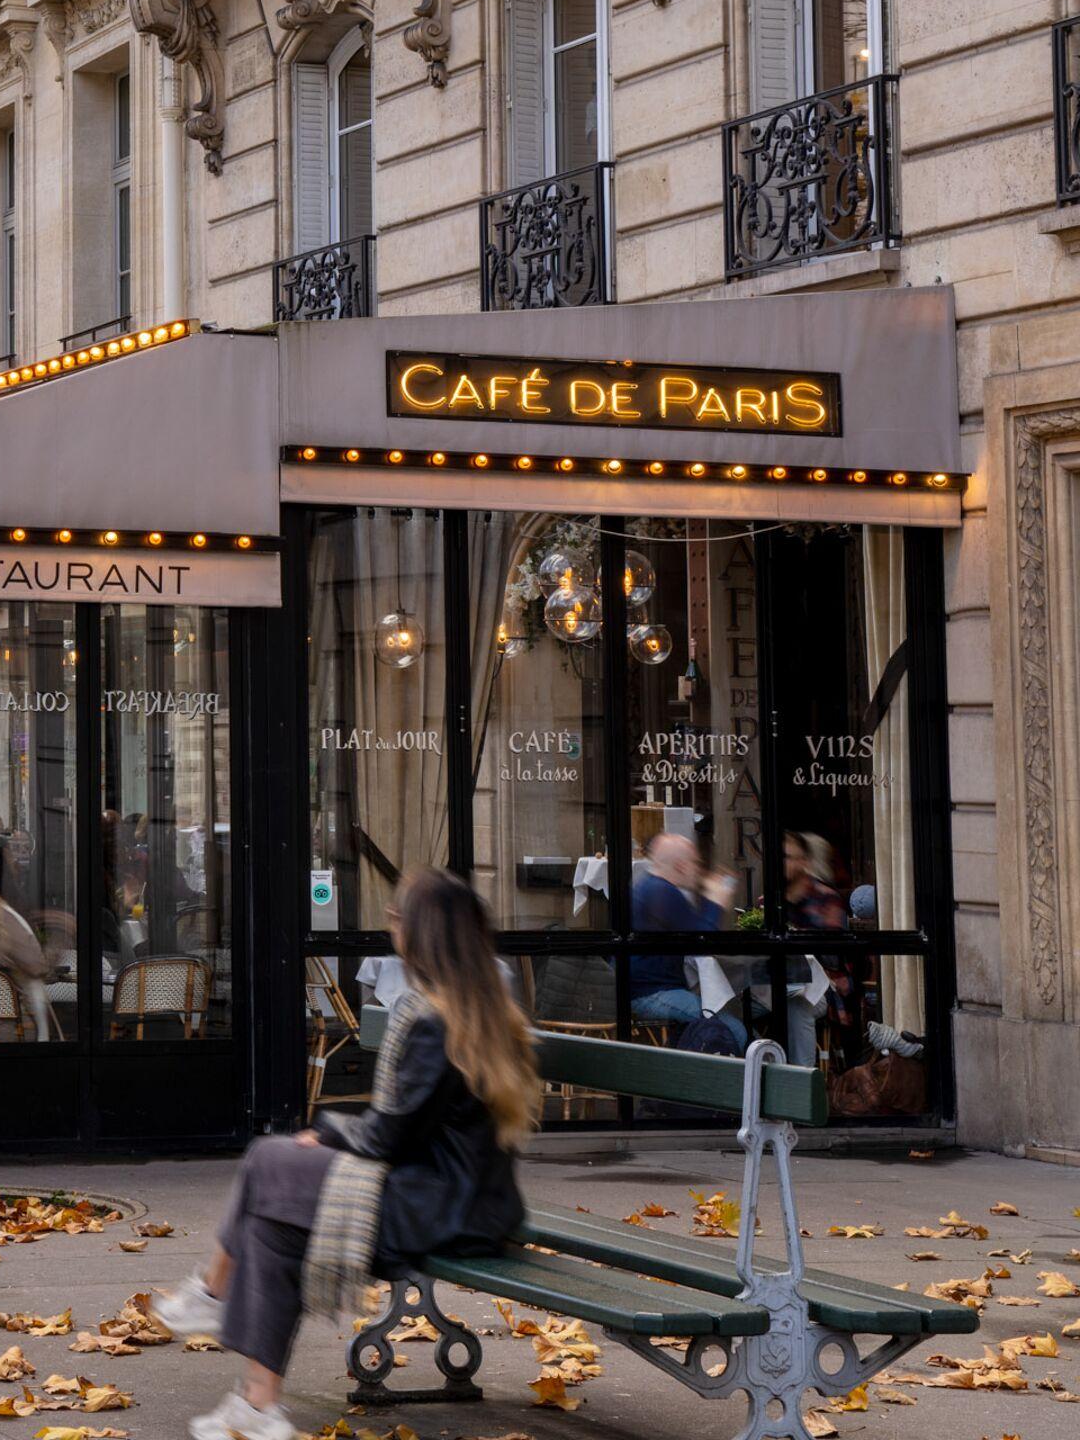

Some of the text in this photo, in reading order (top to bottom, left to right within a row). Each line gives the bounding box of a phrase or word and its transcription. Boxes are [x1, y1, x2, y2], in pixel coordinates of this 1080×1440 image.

[399, 362, 827, 427] CAFÉ DE PARIS
[321, 727, 442, 756] PLAT du JOUR
[509, 728, 573, 753] CAFÉ
[638, 731, 749, 759] APÉRITIFS
[805, 734, 874, 759] VINS
[500, 758, 578, 782] à la tasse
